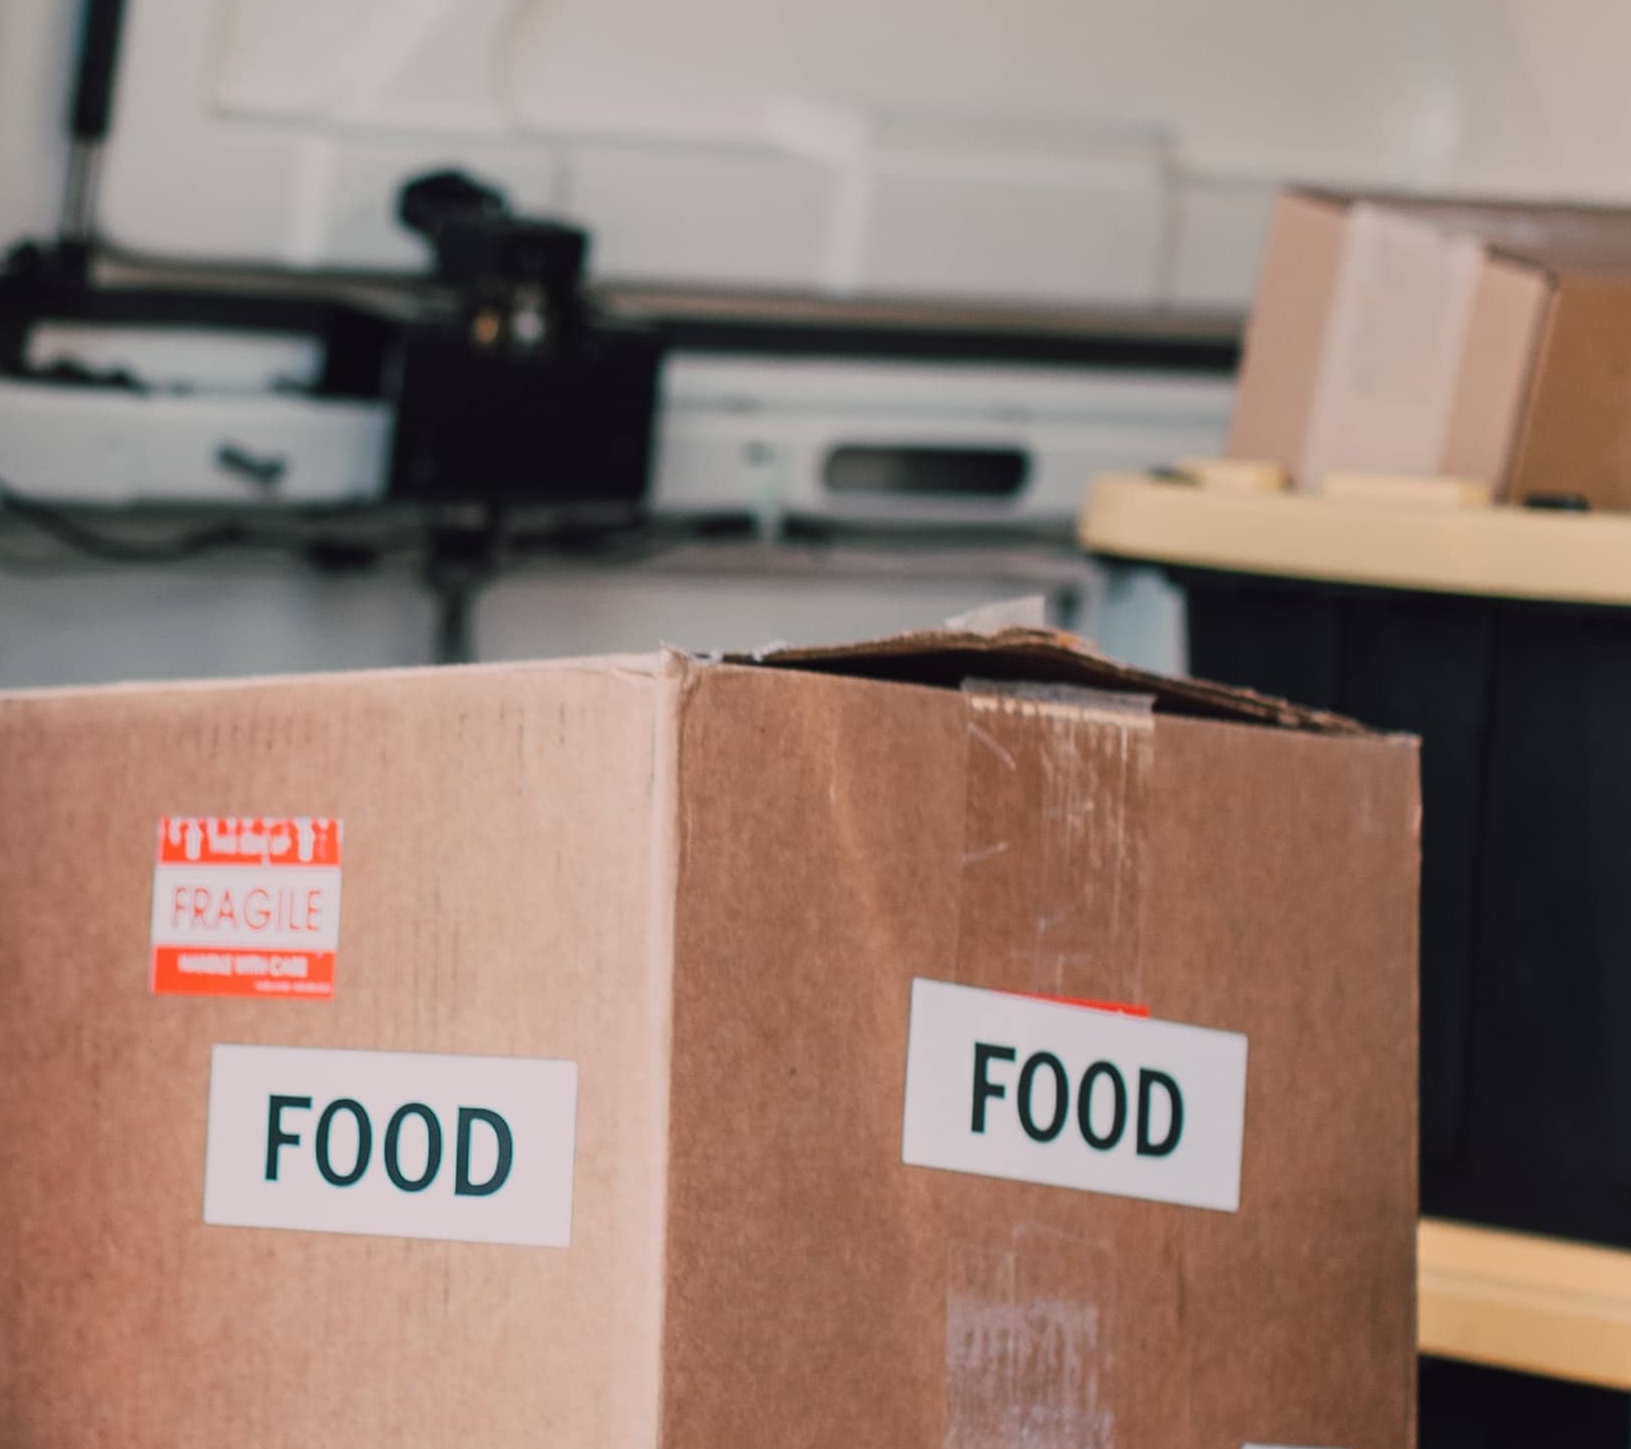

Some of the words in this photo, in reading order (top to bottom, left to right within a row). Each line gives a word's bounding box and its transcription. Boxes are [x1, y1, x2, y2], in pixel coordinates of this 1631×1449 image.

[171, 885, 322, 932] FRAGILE
[265, 1093, 514, 1198] FOOD
[969, 1040, 1185, 1159] FOOD
